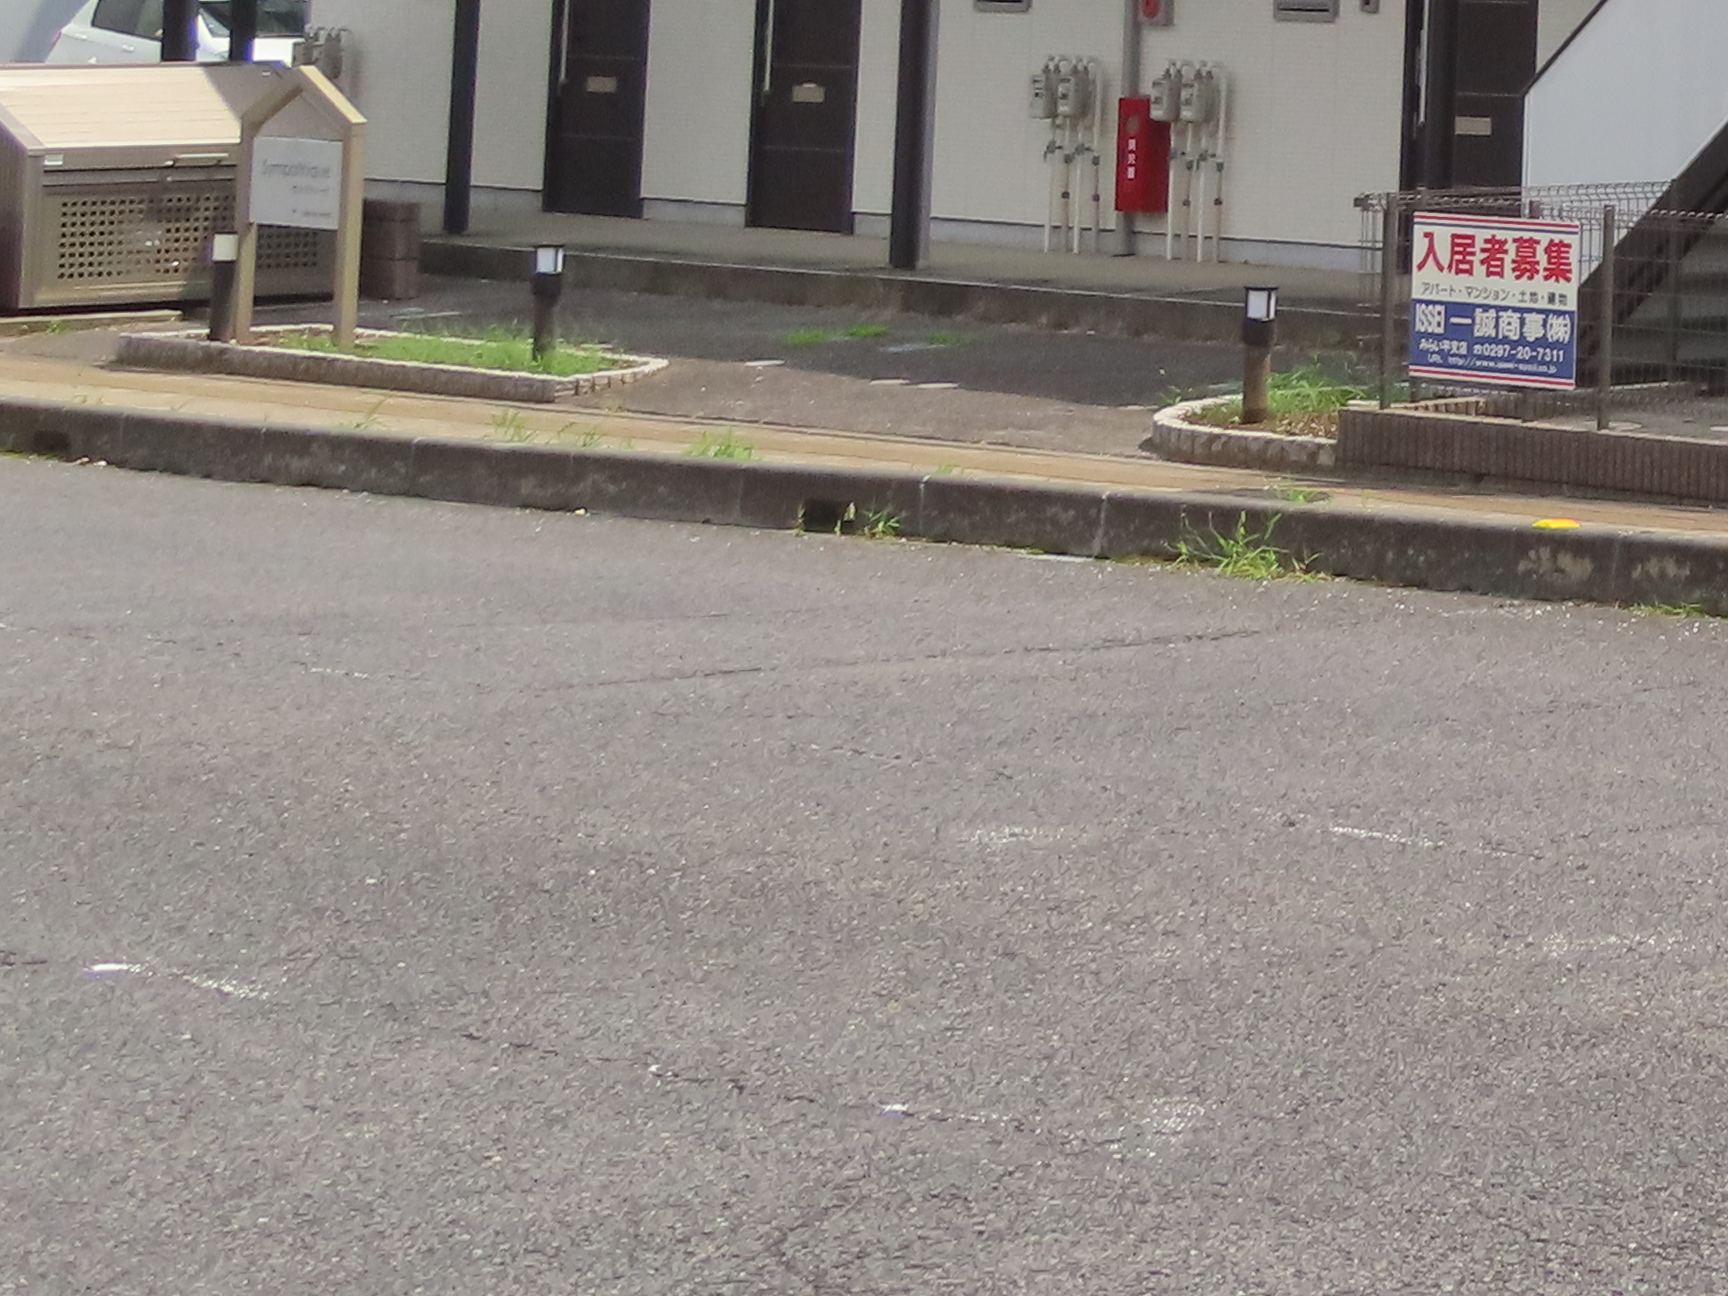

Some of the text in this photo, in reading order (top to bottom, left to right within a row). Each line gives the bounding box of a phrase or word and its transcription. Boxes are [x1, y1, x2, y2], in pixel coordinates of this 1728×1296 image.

[1416, 231, 1573, 283] 入居者募集
